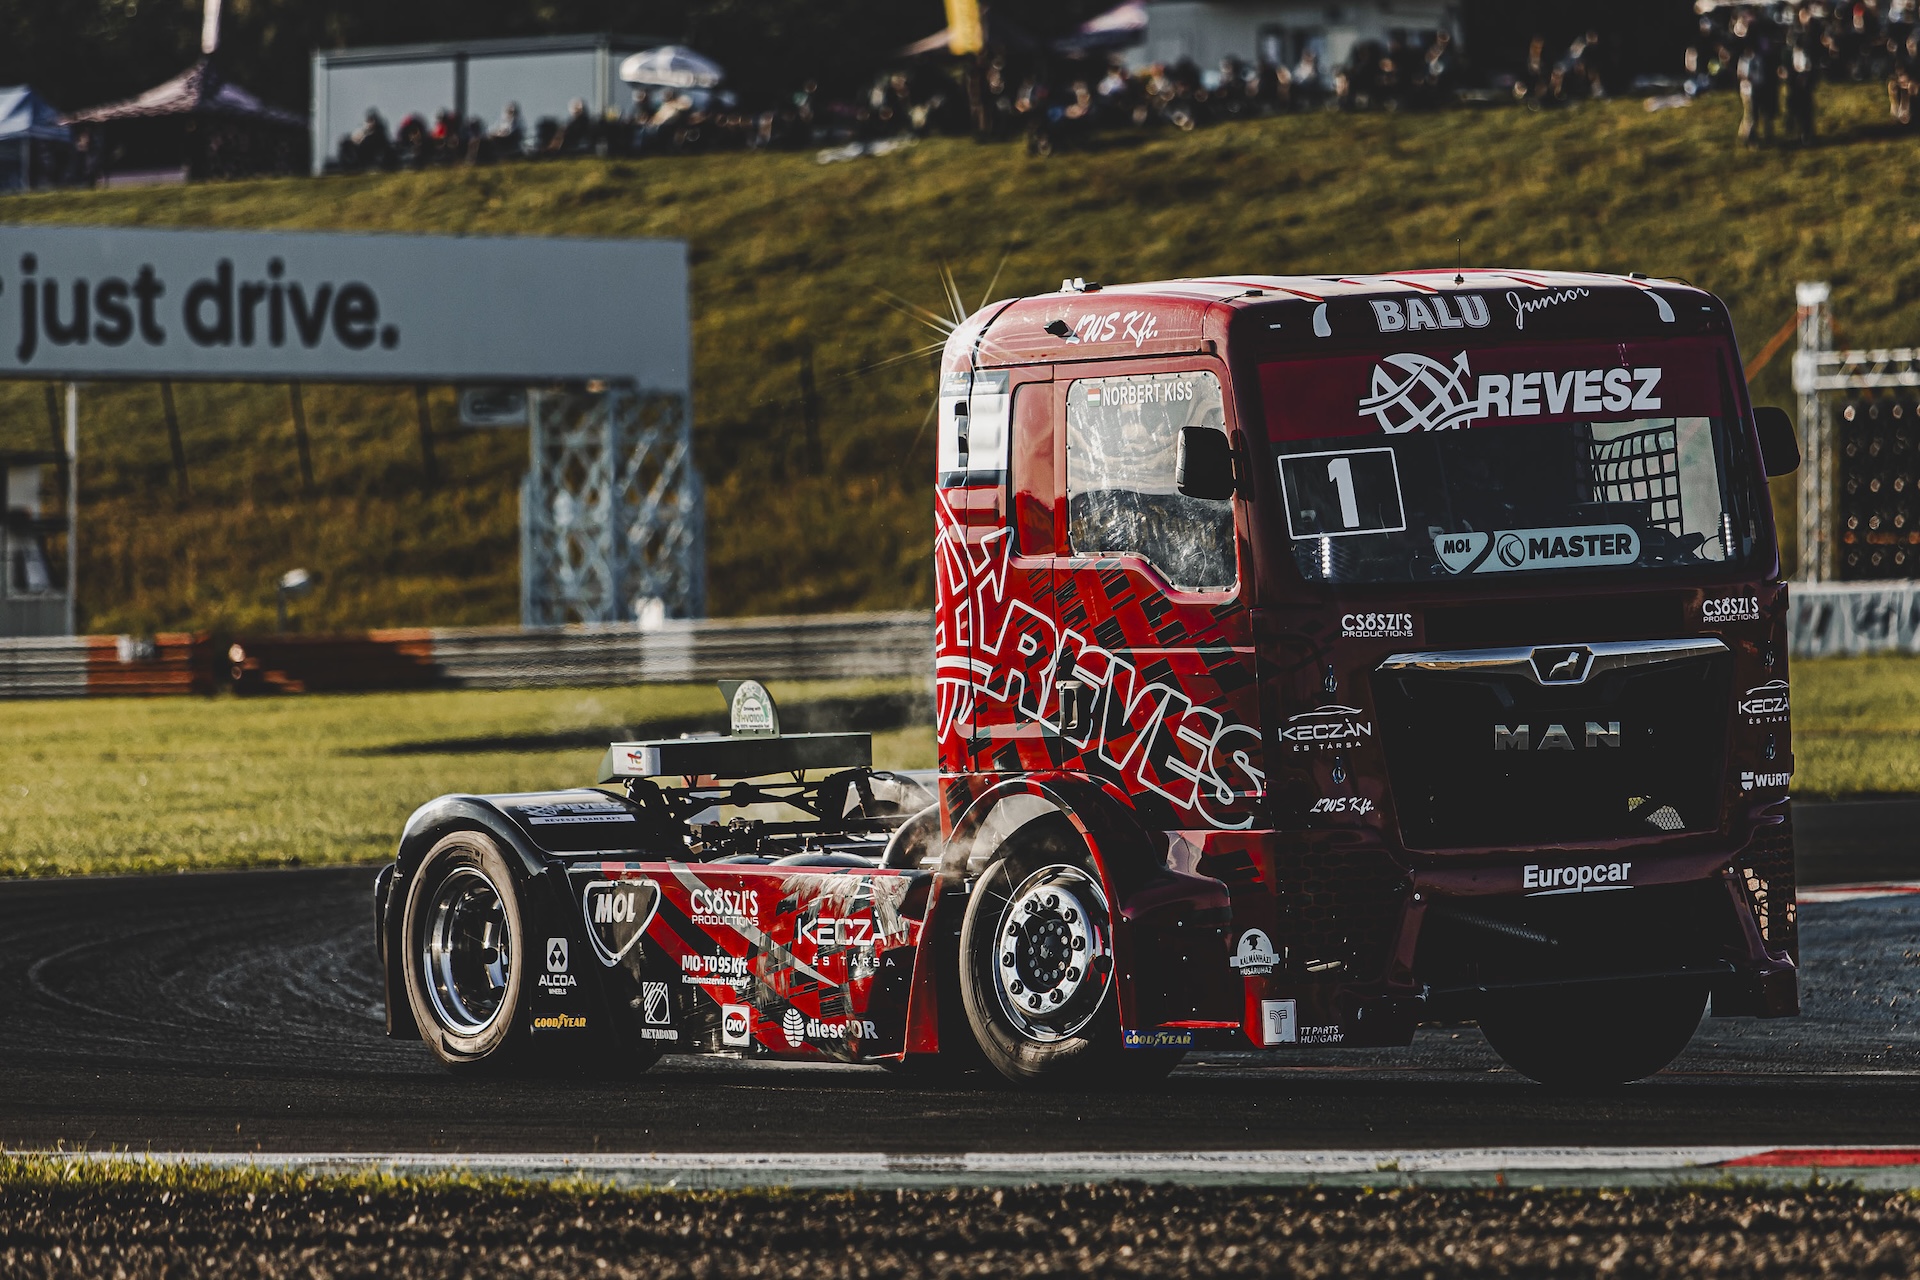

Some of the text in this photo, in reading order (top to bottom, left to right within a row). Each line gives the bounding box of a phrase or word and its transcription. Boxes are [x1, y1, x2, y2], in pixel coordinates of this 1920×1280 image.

[16, 251, 400, 365] just drive.
[1368, 286, 1590, 333] BALU Junior
[1065, 310, 1159, 348] LWS Kft.
[1101, 380, 1194, 407] NORBERT KISS
[1477, 367, 1662, 417] REVESZ
[1327, 457, 1360, 528] 1
[1442, 538, 1472, 554] MOL
[1528, 533, 1633, 560] MASTER
[1703, 613, 1760, 623] PRODUCTIONS
[1342, 630, 1413, 638] PRODUCTIONS
[1748, 715, 1790, 725] ÉS TÁRS
[1494, 721, 1621, 750] MAN
[1293, 741, 1362, 752] ÉS TÁRSA
[1309, 797, 1375, 815] LWS Kft.
[1523, 862, 1632, 892] Europcar
[594, 892, 637, 923] MOL
[691, 915, 760, 927] PRODUCTIONS
[717, 956, 731, 973] 95
[731, 957, 748, 977] Kft
[811, 953, 895, 967] ÉS TÁRSA
[537, 974, 577, 987] ALCOA
[534, 1014, 587, 1029] GOODYEAR
[725, 1019, 746, 1032] DKV
[1300, 1025, 1339, 1035] TT PARTS
[1125, 1032, 1192, 1046] GOODYEAR
[1300, 1034, 1345, 1044] HUNGARY
